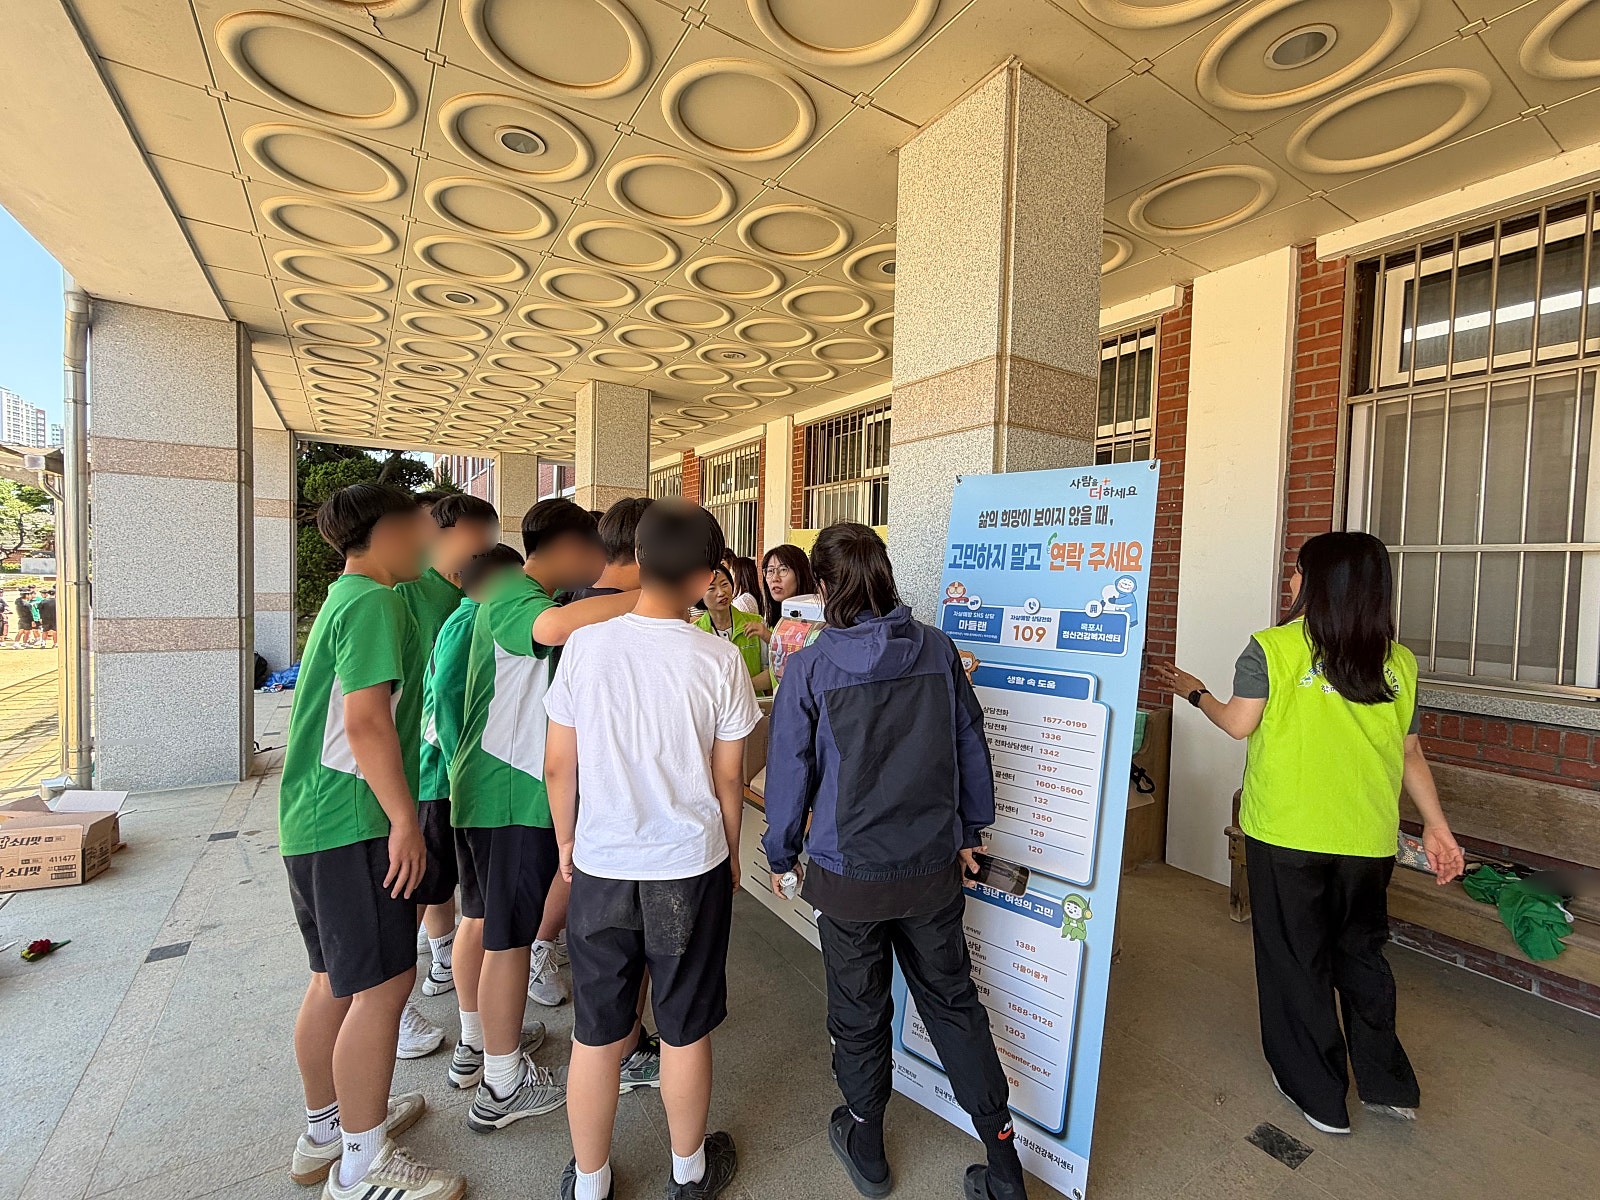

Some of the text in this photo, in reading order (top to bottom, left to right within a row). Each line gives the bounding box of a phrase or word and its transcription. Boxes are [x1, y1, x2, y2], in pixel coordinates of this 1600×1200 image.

[1070, 475, 1099, 489] 사람을
[1089, 484, 1138, 500] 더하세요
[978, 505, 1114, 528] 삶의 희망이 보이지 않을 때,
[948, 541, 1143, 572] 고민하지 말고 연락 주세요
[958, 620, 988, 632] 마들랜
[1080, 623, 1103, 633] 목포시
[1013, 624, 1047, 643] 109
[1062, 630, 1121, 643] 정신건강복지센터
[1007, 675, 1057, 690] 생활 속 도움
[1042, 716, 1088, 729] 1577-0199
[1041, 732, 1062, 741] 1336
[994, 738, 1034, 753] 전화상담센터
[1039, 748, 1060, 757] 1342
[1037, 764, 1058, 773] 1397
[1035, 780, 1084, 796] 1600-5500
[1033, 796, 1049, 805] 132
[1031, 812, 1052, 823] 1350
[1030, 828, 1045, 838] 129
[9, 836, 42, 847] 소다맛
[1028, 845, 1043, 854] 120
[48, 854, 76, 862] 411477
[5, 866, 42, 878] 소다맛
[1004, 894, 1032, 911] 여성의
[1033, 904, 1054, 918] 고민
[967, 940, 982, 952] 상담
[1015, 940, 1036, 953] 1388
[1008, 1002, 1053, 1028] 1588-9128
[1005, 1025, 1026, 1040] 1303
